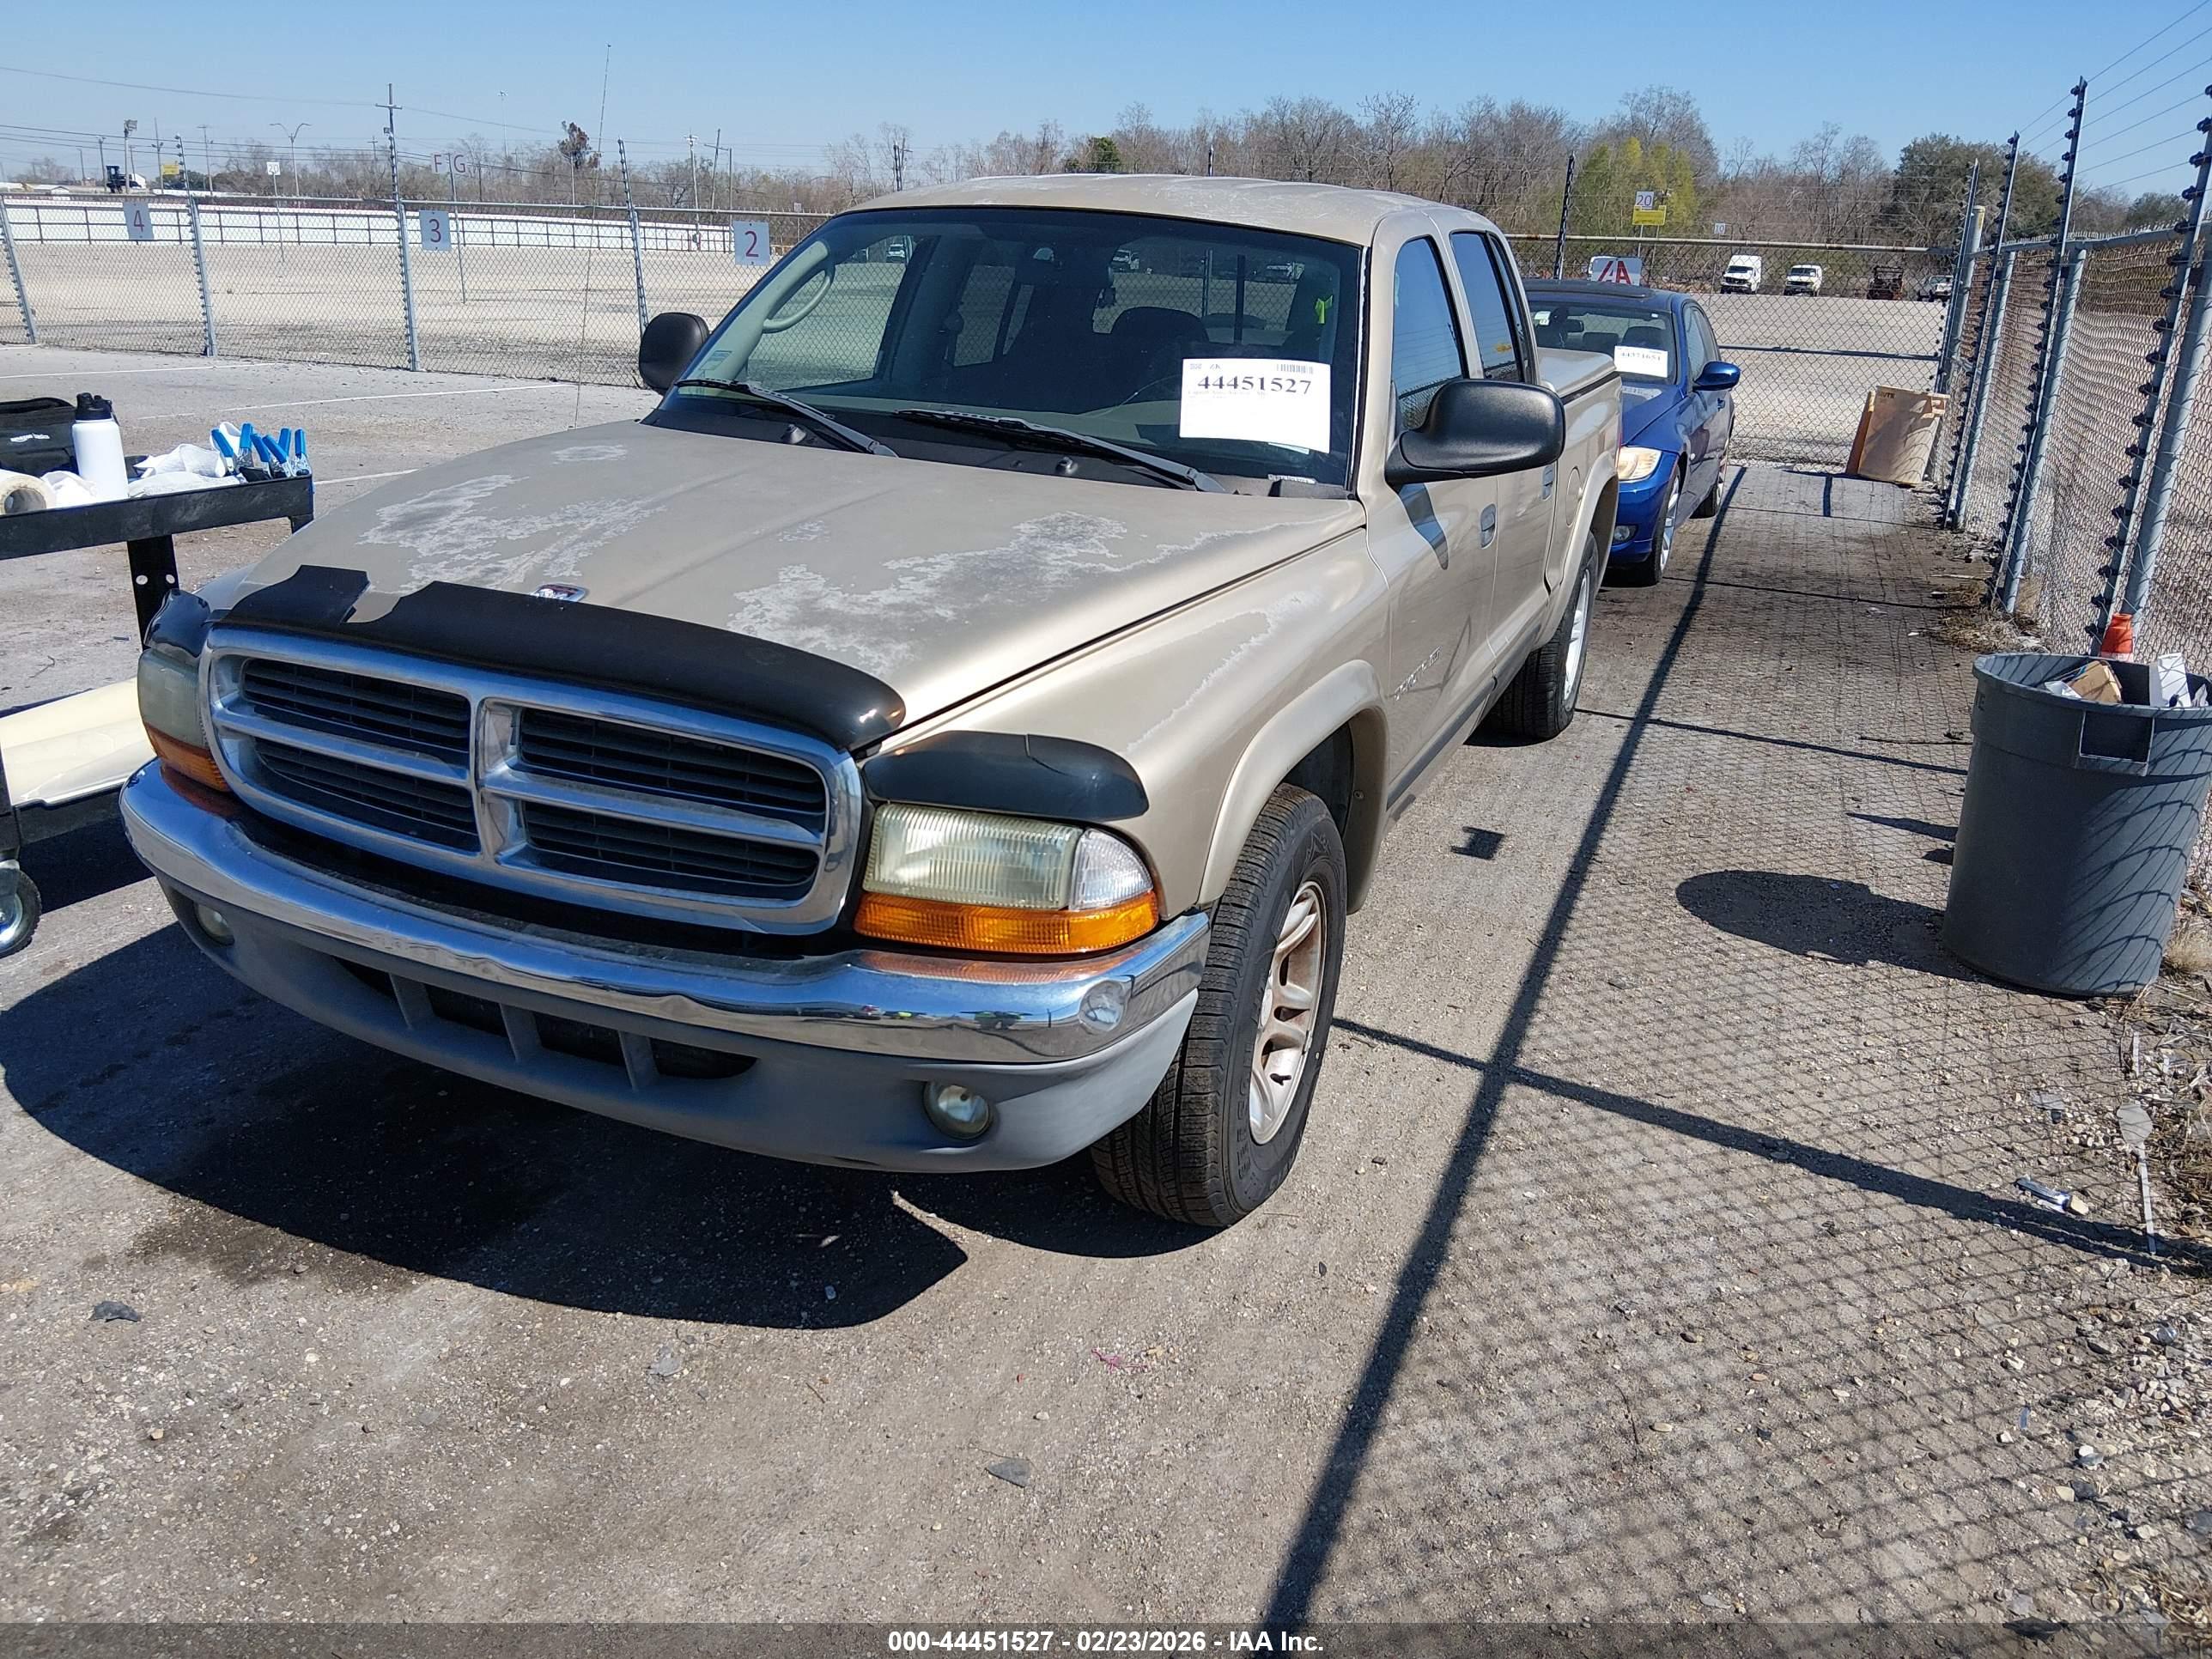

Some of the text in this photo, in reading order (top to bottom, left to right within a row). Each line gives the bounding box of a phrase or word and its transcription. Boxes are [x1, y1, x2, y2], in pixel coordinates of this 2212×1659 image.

[434, 154, 442, 173] F
[453, 154, 466, 173] G
[1636, 194, 1652, 206] 20
[133, 210, 145, 232] 4
[428, 218, 441, 243] 3
[744, 230, 759, 258] 2
[1197, 375, 1312, 395] 44451527
